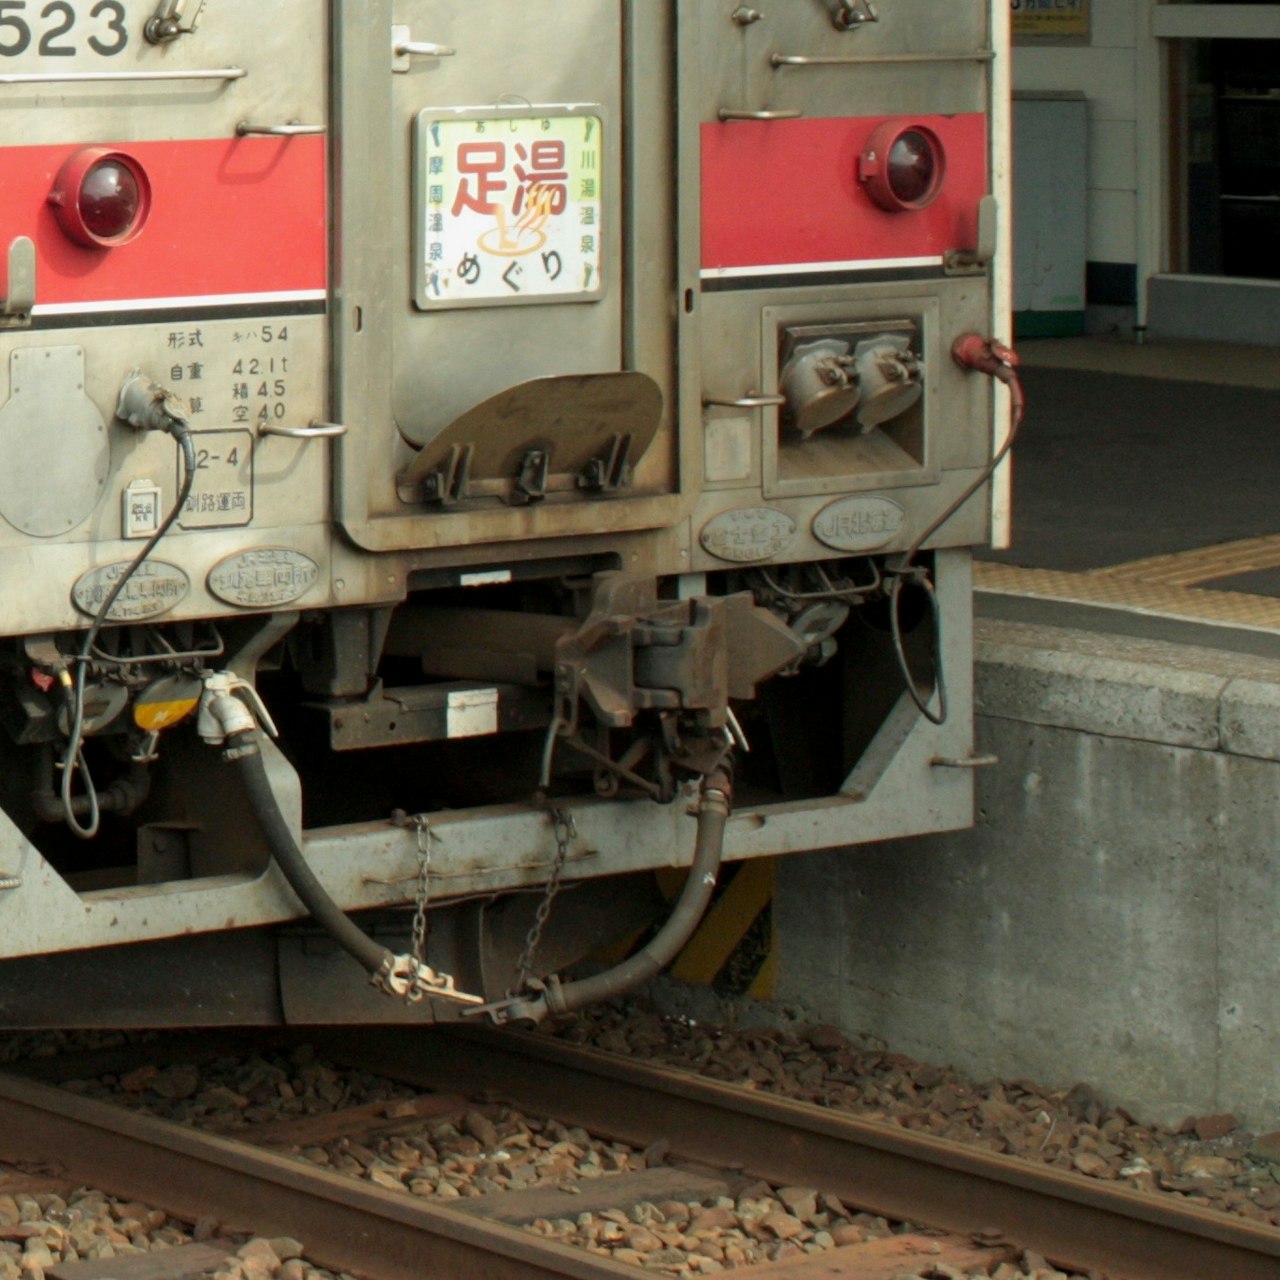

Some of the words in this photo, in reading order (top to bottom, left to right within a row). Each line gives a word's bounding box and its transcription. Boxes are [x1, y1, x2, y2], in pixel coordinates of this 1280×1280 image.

[451, 140, 568, 217] 足湯
[429, 156, 443, 261] 摩周温泉
[581, 150, 595, 253] 川湯温泉
[457, 250, 562, 292] めぐり
[167, 328, 203, 349] 形式
[170, 362, 203, 380] 自重
[232, 405, 248, 422] 空
